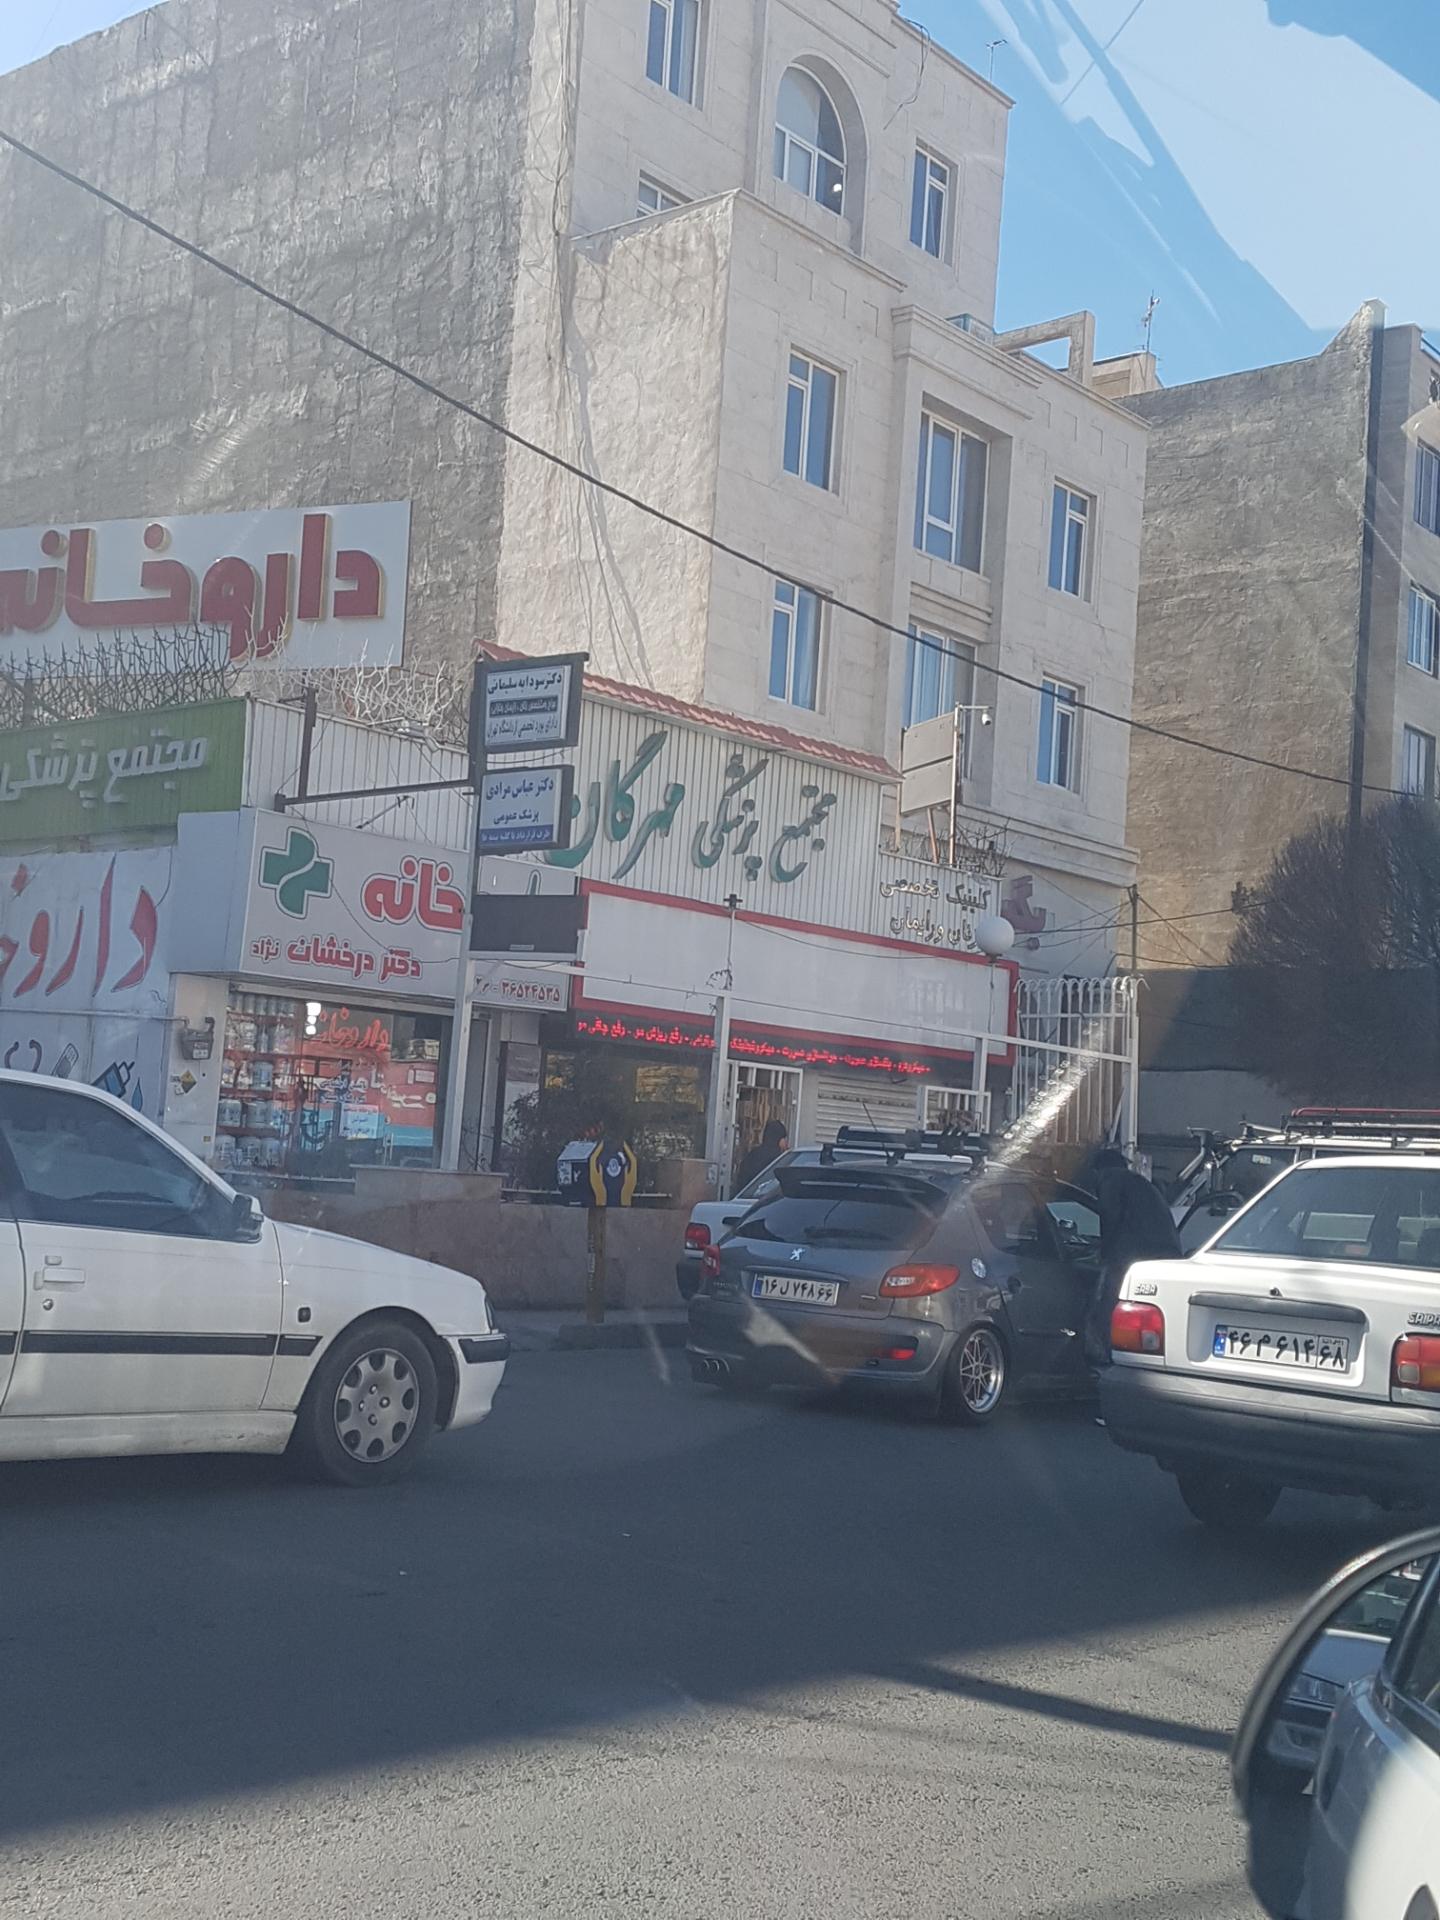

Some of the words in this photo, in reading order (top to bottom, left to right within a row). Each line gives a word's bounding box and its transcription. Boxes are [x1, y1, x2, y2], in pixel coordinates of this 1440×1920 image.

[544, 672, 562, 690] دکتر
[0, 733, 98, 809] پزشکی
[104, 729, 208, 803] مجتمع
[486, 781, 511, 800] مرادی
[512, 779, 534, 798] عباس
[536, 777, 554, 797] دکتر
[543, 731, 685, 879] مهرگان
[692, 753, 769, 882] پزشکی
[769, 784, 837, 883] مجتمع
[361, 856, 464, 931] خانه
[880, 878, 940, 900] تخصصی
[946, 883, 991, 914] کلینیک
[252, 938, 280, 960] نژاد
[288, 936, 374, 978] درخشان
[380, 947, 421, 981] دکتر
